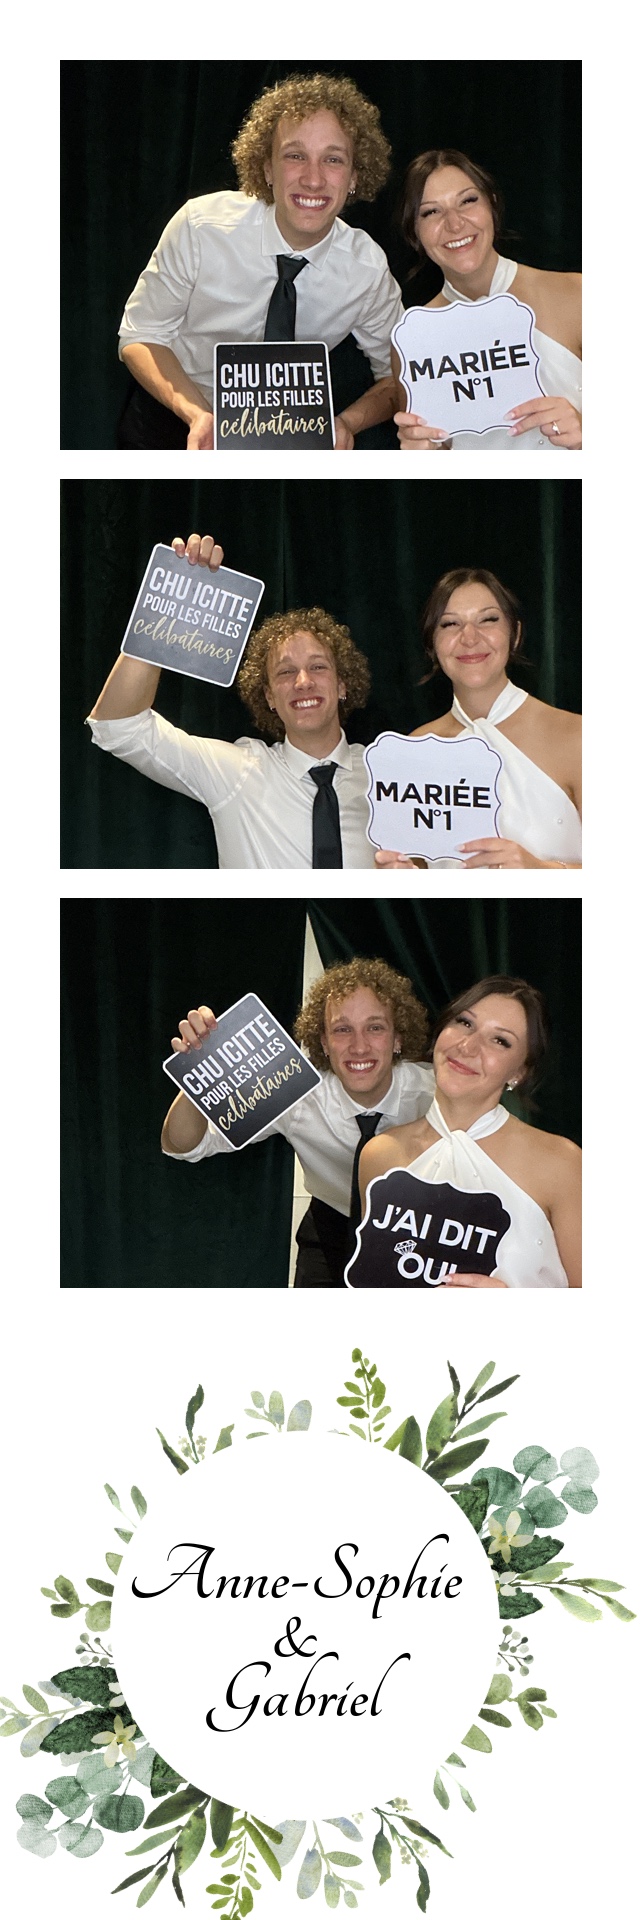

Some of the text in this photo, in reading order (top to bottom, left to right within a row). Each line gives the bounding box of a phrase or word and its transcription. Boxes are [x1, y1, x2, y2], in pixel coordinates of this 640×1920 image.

[220, 362, 325, 388] CHU ICITTE
[409, 340, 530, 382] MARIÉE
[221, 389, 324, 408] POUR LES FILLES
[452, 376, 494, 402] N°1
[220, 407, 328, 438] célibataires
[142, 593, 242, 639] POUR LES FILLES
[149, 567, 253, 622] CHU ICITTE
[133, 616, 236, 664] célibataires
[376, 778, 491, 808] MARIÉE
[413, 807, 452, 831] N°1
[182, 1013, 277, 1096] CHU ICITTE
[200, 1037, 286, 1111] POUR LES FILLES
[218, 1057, 302, 1131] célibataires
[372, 1204, 498, 1254] J'AI DIT
